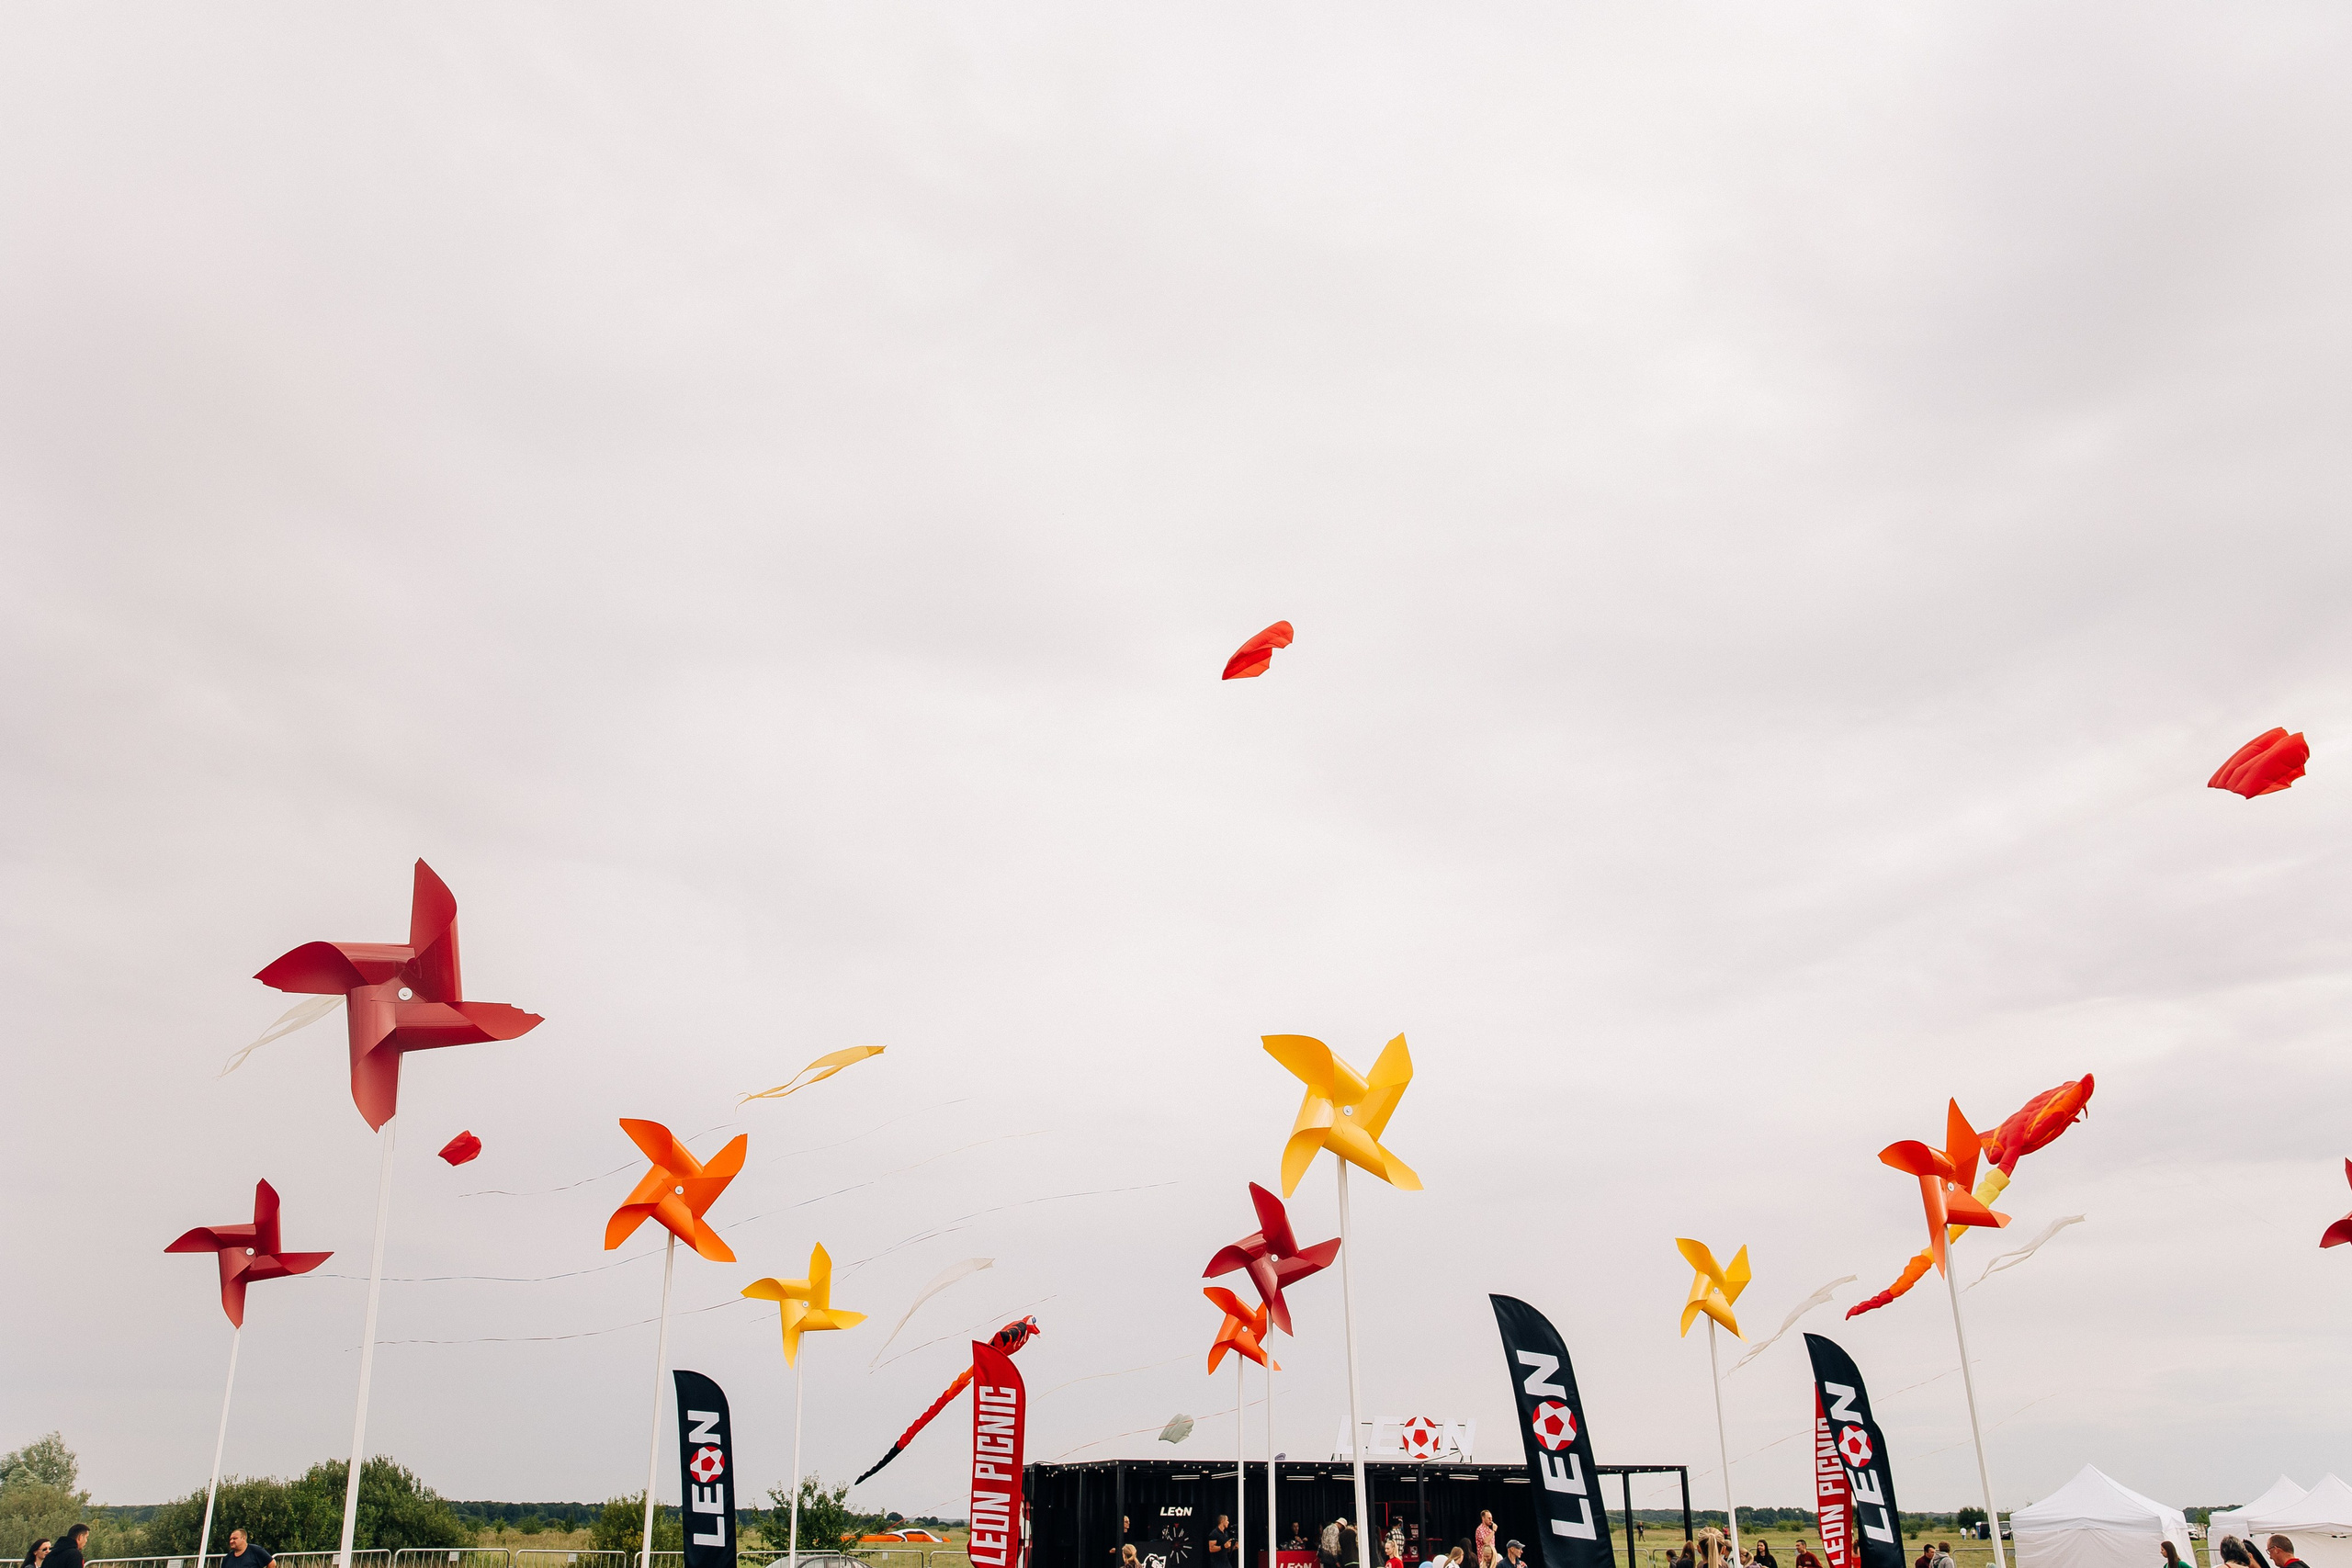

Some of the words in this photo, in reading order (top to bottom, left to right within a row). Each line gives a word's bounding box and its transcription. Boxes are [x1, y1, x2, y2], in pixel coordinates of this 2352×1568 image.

[687, 1409, 726, 1547] LEON
[975, 1385, 1017, 1482] PICNIC
[1516, 1349, 1597, 1540] LEON
[1825, 1381, 1894, 1543] LEON
[970, 1490, 1011, 1567] LEON
[1159, 1506, 1193, 1517] LEON
[1820, 1504, 1845, 1566] LEON
